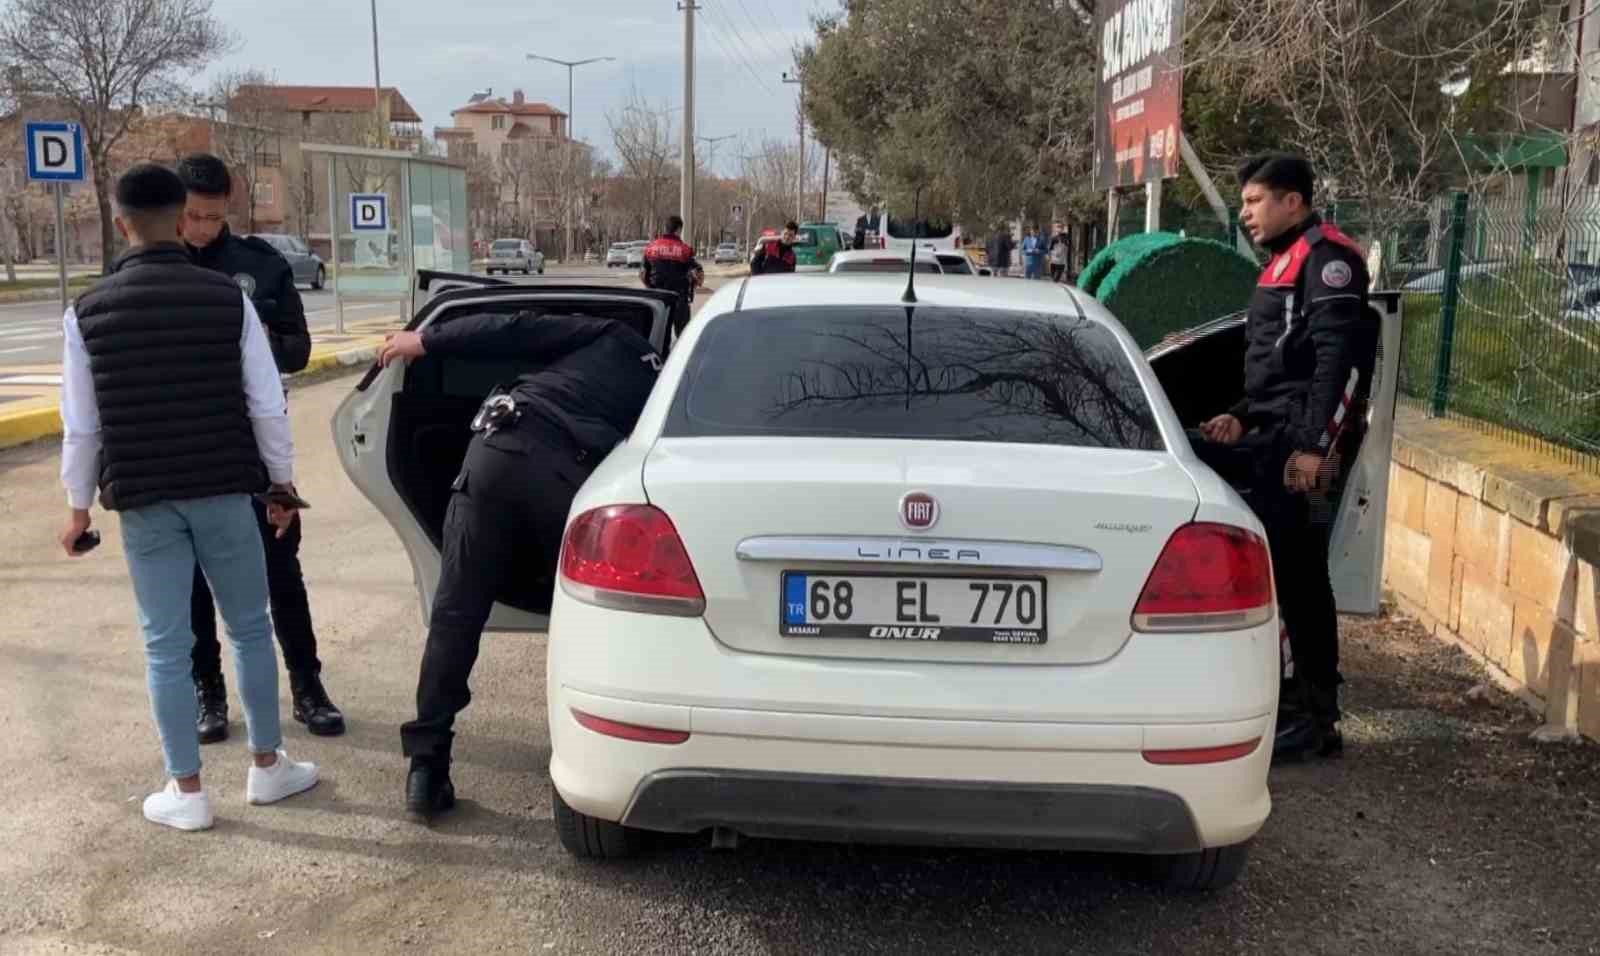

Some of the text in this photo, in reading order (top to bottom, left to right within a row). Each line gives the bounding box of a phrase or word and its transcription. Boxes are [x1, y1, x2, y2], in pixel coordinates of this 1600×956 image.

[42, 136, 67, 167] D
[362, 204, 375, 221] D
[908, 502, 931, 520] FIAT
[858, 547, 981, 561] LINEA
[788, 602, 804, 616] TR
[810, 580, 1036, 625] 68 EL 770
[869, 626, 941, 640] ONUR
